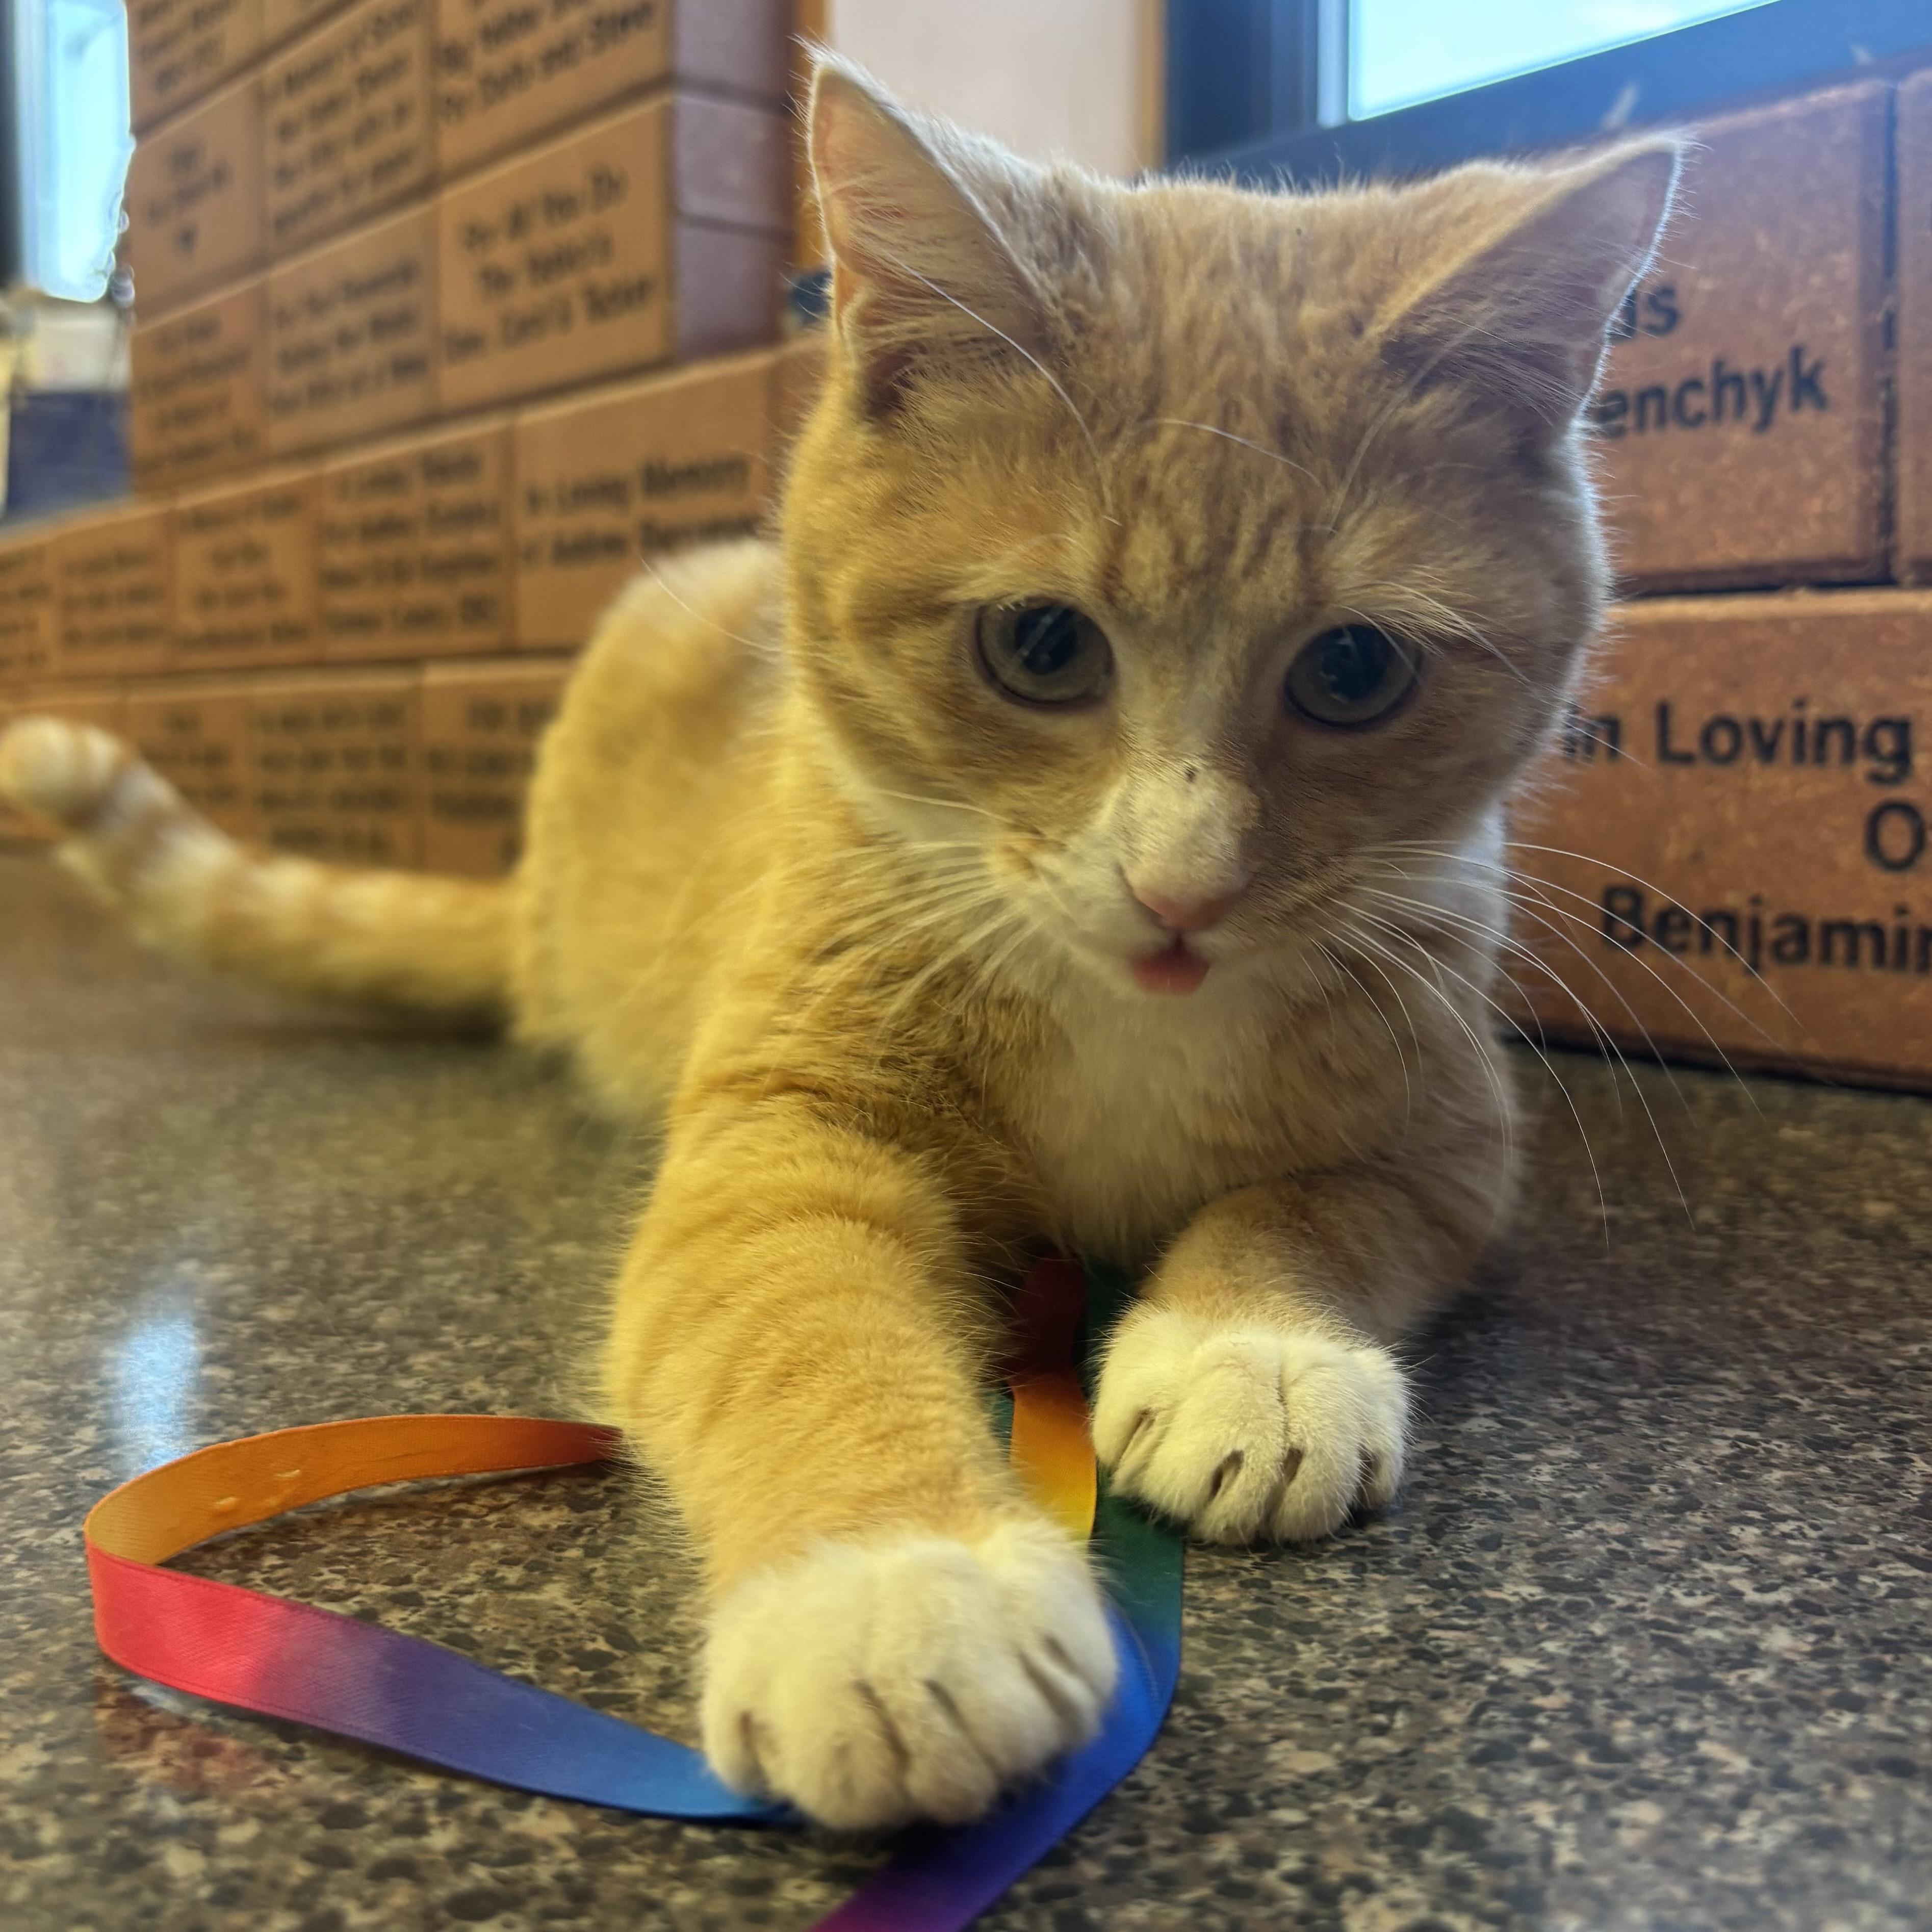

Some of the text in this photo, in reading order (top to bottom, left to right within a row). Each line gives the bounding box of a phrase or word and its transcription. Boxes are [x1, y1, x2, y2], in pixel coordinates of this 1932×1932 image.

[1561, 698, 1913, 786] In Loving
[1864, 798, 1932, 873] O
